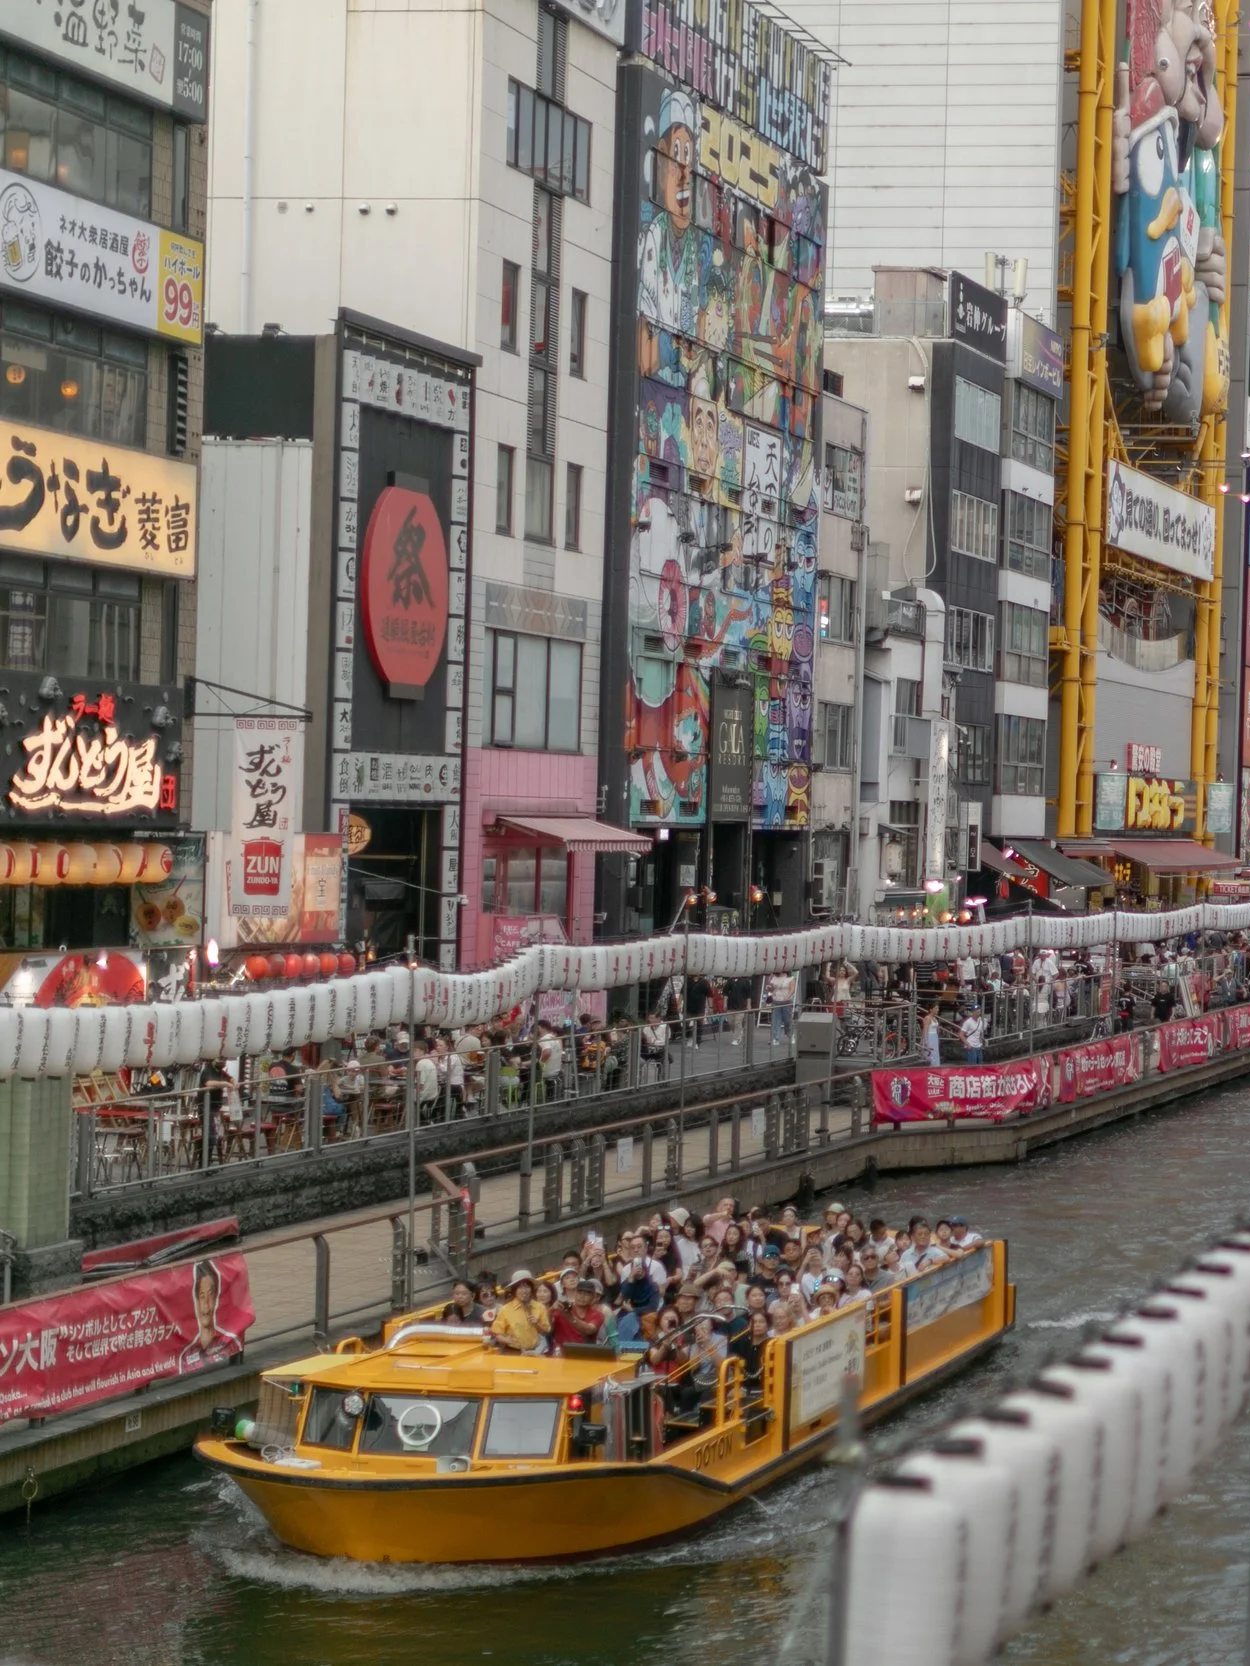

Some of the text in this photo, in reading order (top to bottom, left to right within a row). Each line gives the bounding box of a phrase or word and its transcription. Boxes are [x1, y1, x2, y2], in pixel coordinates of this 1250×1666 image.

[178, 41, 203, 70] 17:00
[700, 103, 780, 209] 2025
[59, 214, 130, 257] ネオ大衆居酒屋
[44, 238, 152, 304] 餃子のかっちゃん
[164, 256, 201, 281] ハイボール
[164, 277, 193, 327] 99
[0, 435, 131, 550] うなぎ
[386, 505, 437, 610] 祭
[11, 713, 162, 812] ずんどう屋
[246, 856, 281, 874] ZUN
[66, 1322, 182, 1363] そして世界で咲き誇るクラブへ
[68, 1306, 159, 1342] シンボルとして、アジア、
[73, 1386, 85, 1398] that
[85, 1382, 96, 1394] will
[96, 1372, 119, 1389] flourish
[127, 1367, 141, 1380] Asia
[142, 1363, 155, 1376] and
[695, 1432, 734, 1470] DOTON
